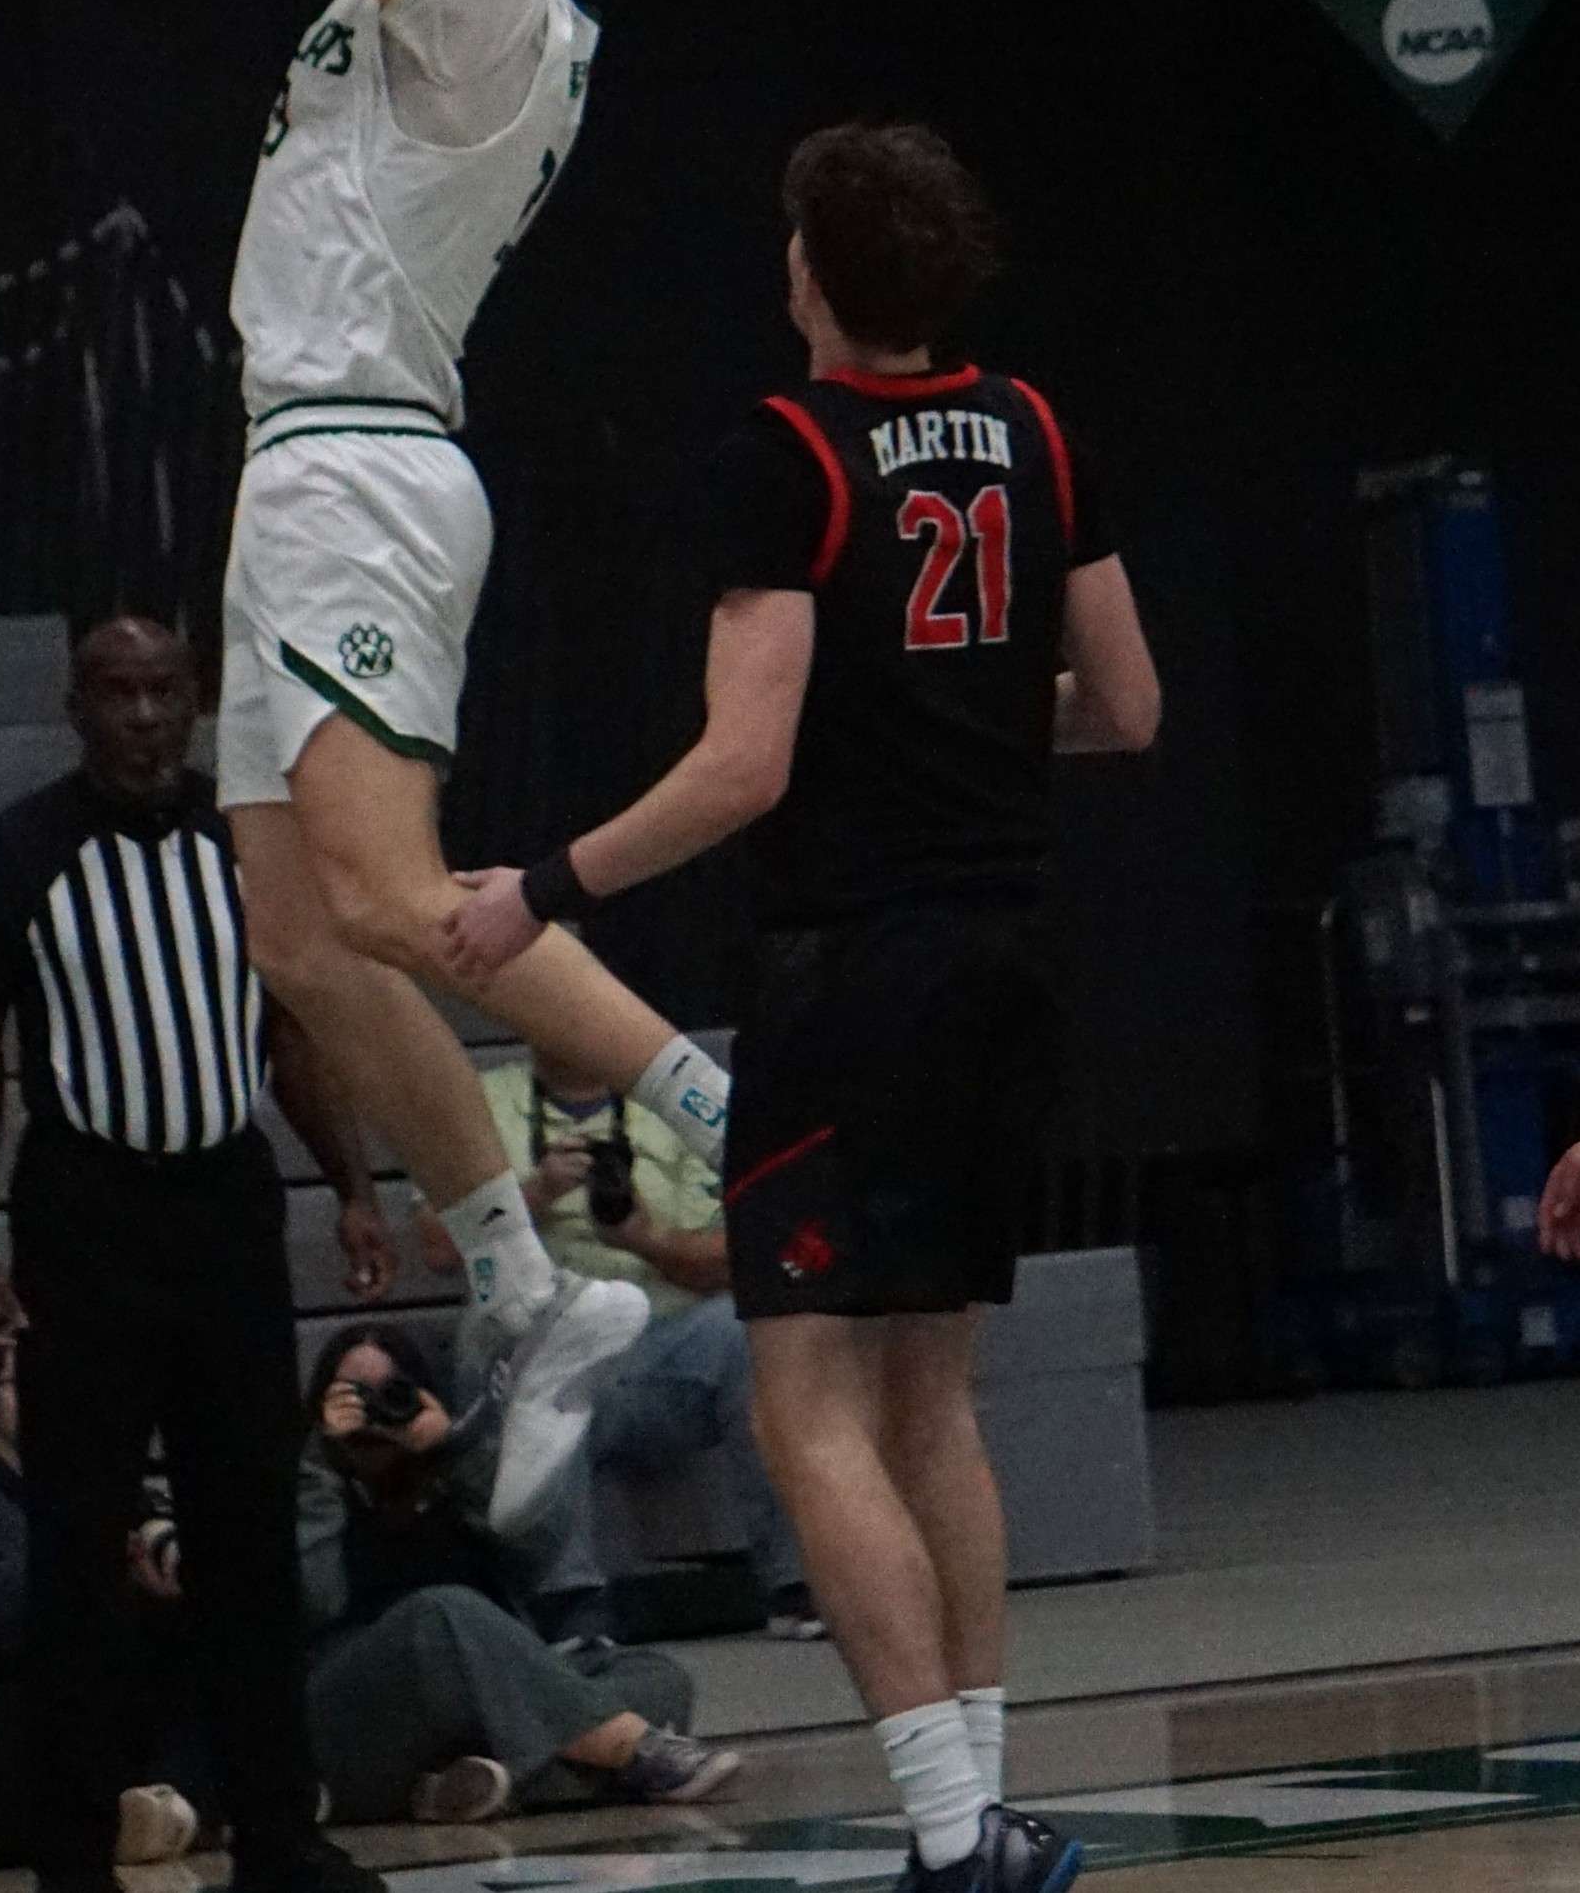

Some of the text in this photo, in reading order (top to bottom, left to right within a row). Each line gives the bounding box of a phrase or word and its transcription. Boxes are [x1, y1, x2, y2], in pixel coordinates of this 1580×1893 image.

[1398, 27, 1487, 55] NCAA
[869, 409, 1013, 477] MARTIN
[896, 484, 1012, 651] 21
